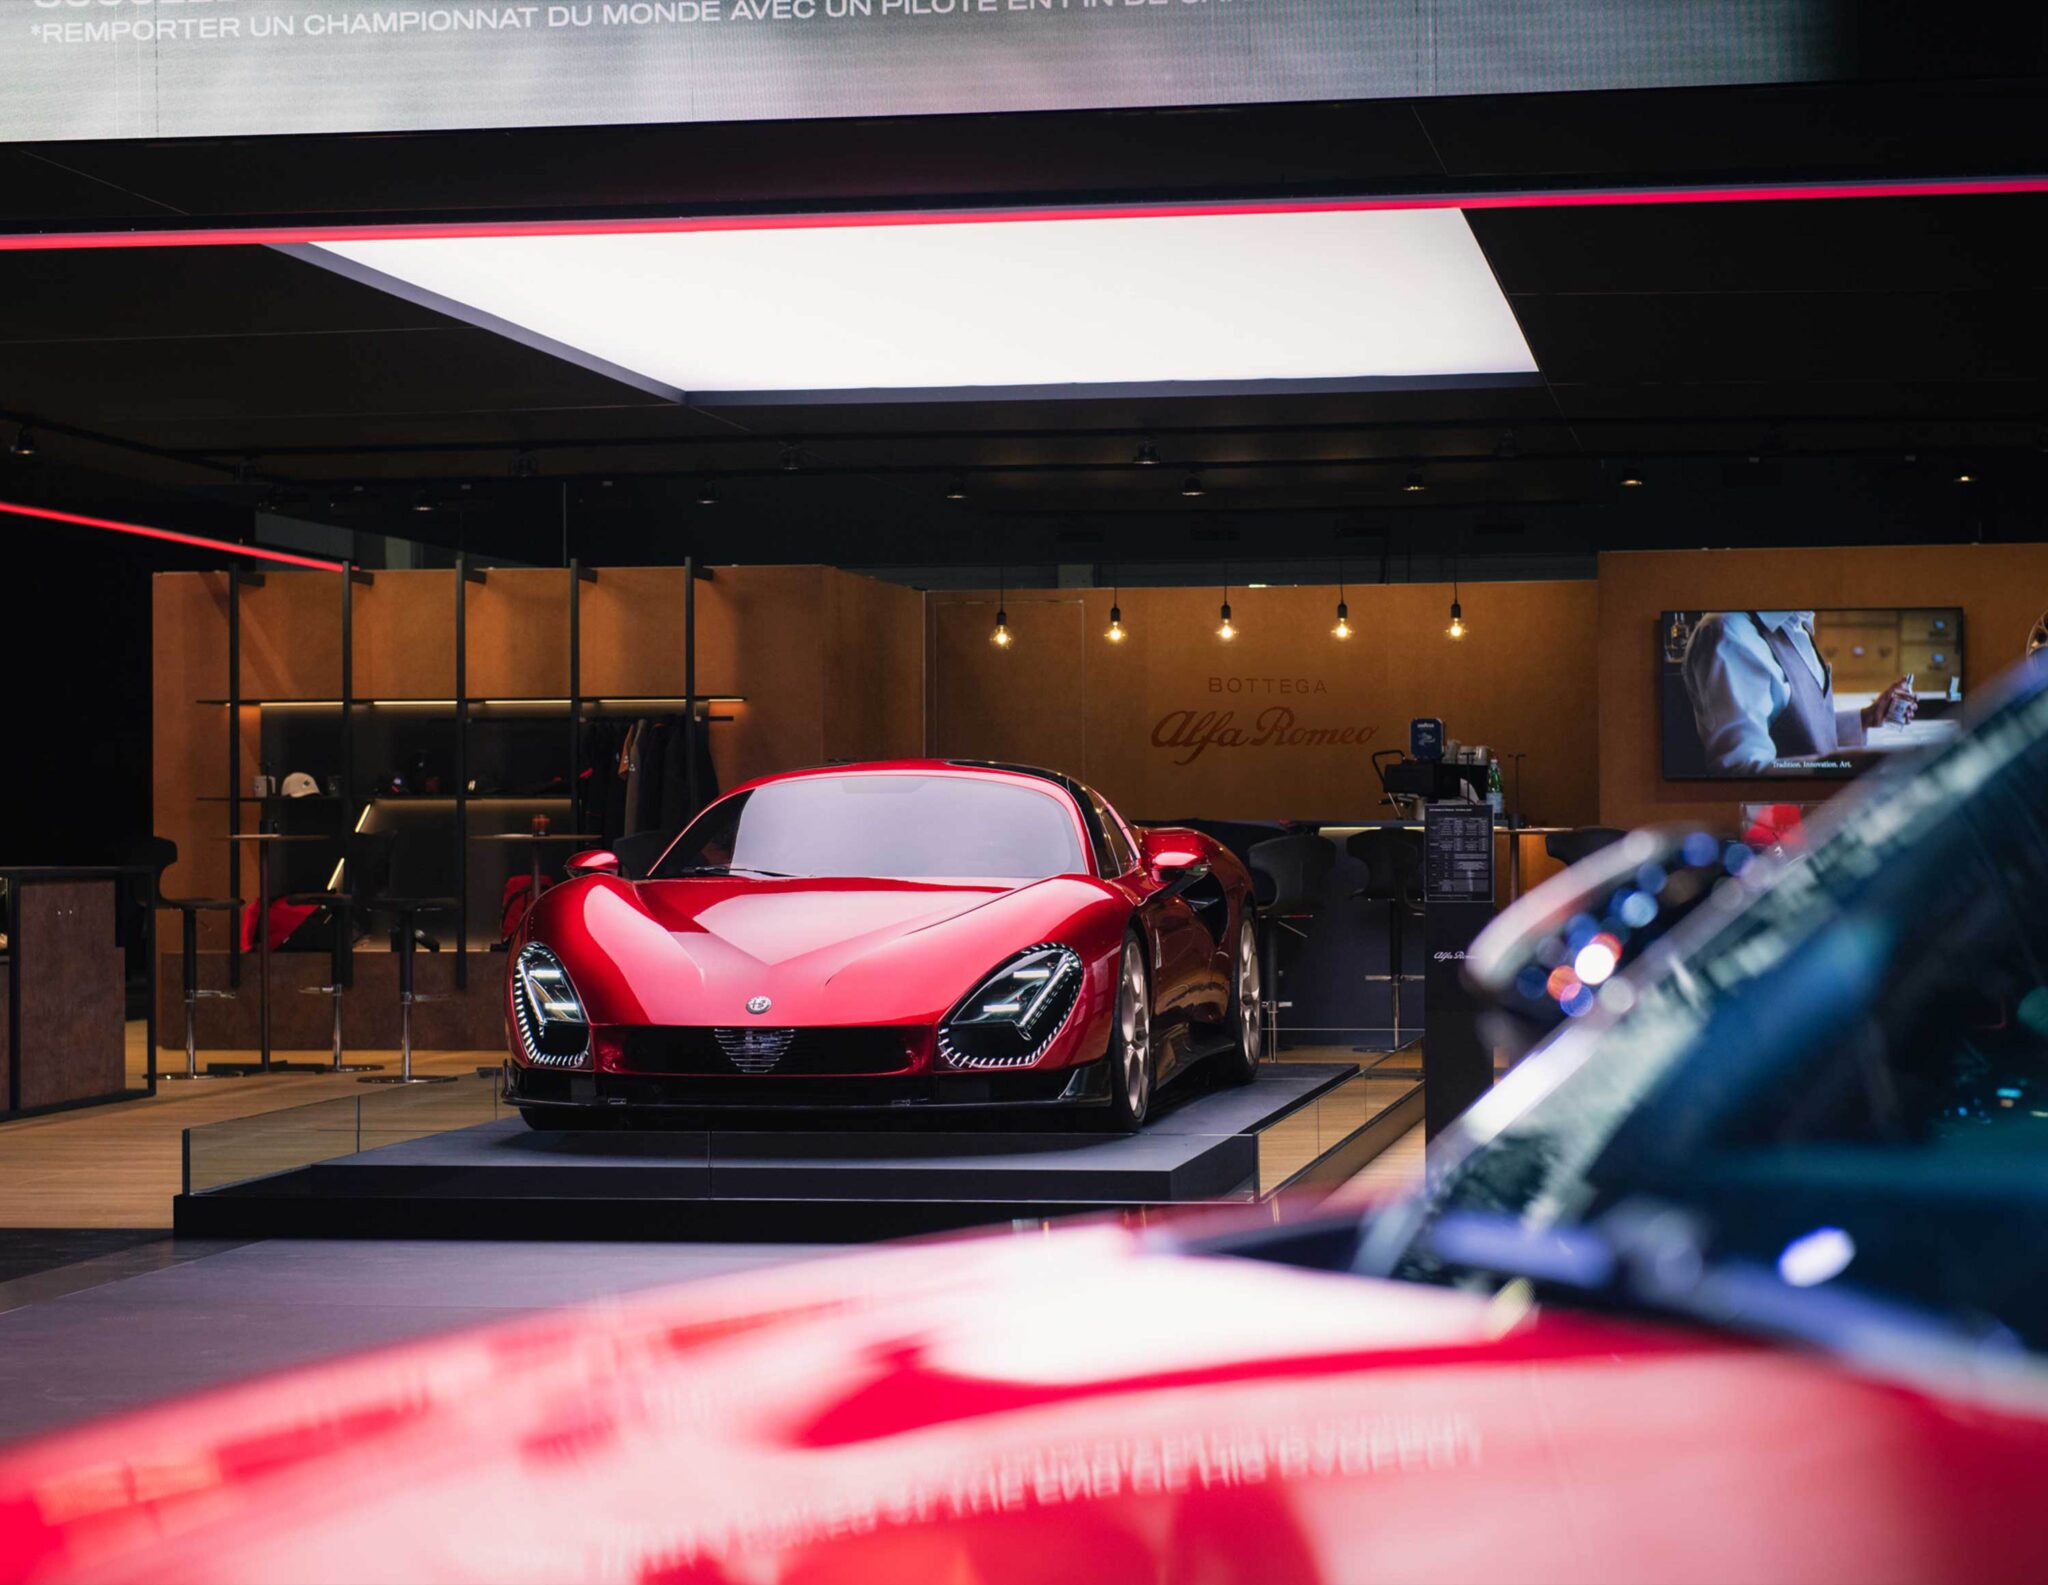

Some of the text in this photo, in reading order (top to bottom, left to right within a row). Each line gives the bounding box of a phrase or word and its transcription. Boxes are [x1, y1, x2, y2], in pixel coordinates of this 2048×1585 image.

[250, 15, 294, 37] UN
[303, 7, 539, 36] CHAMPIONNAT
[548, 5, 592, 27] DU
[602, 1, 721, 25] MONDE
[730, 0, 816, 20] AVEC
[825, 0, 871, 17] UN
[1208, 677, 1328, 694] BOTTEGA
[1151, 706, 1380, 766] Alfa Romeo
[1803, 760, 1838, 769] Innovation.
[1839, 761, 1852, 769] Art.
